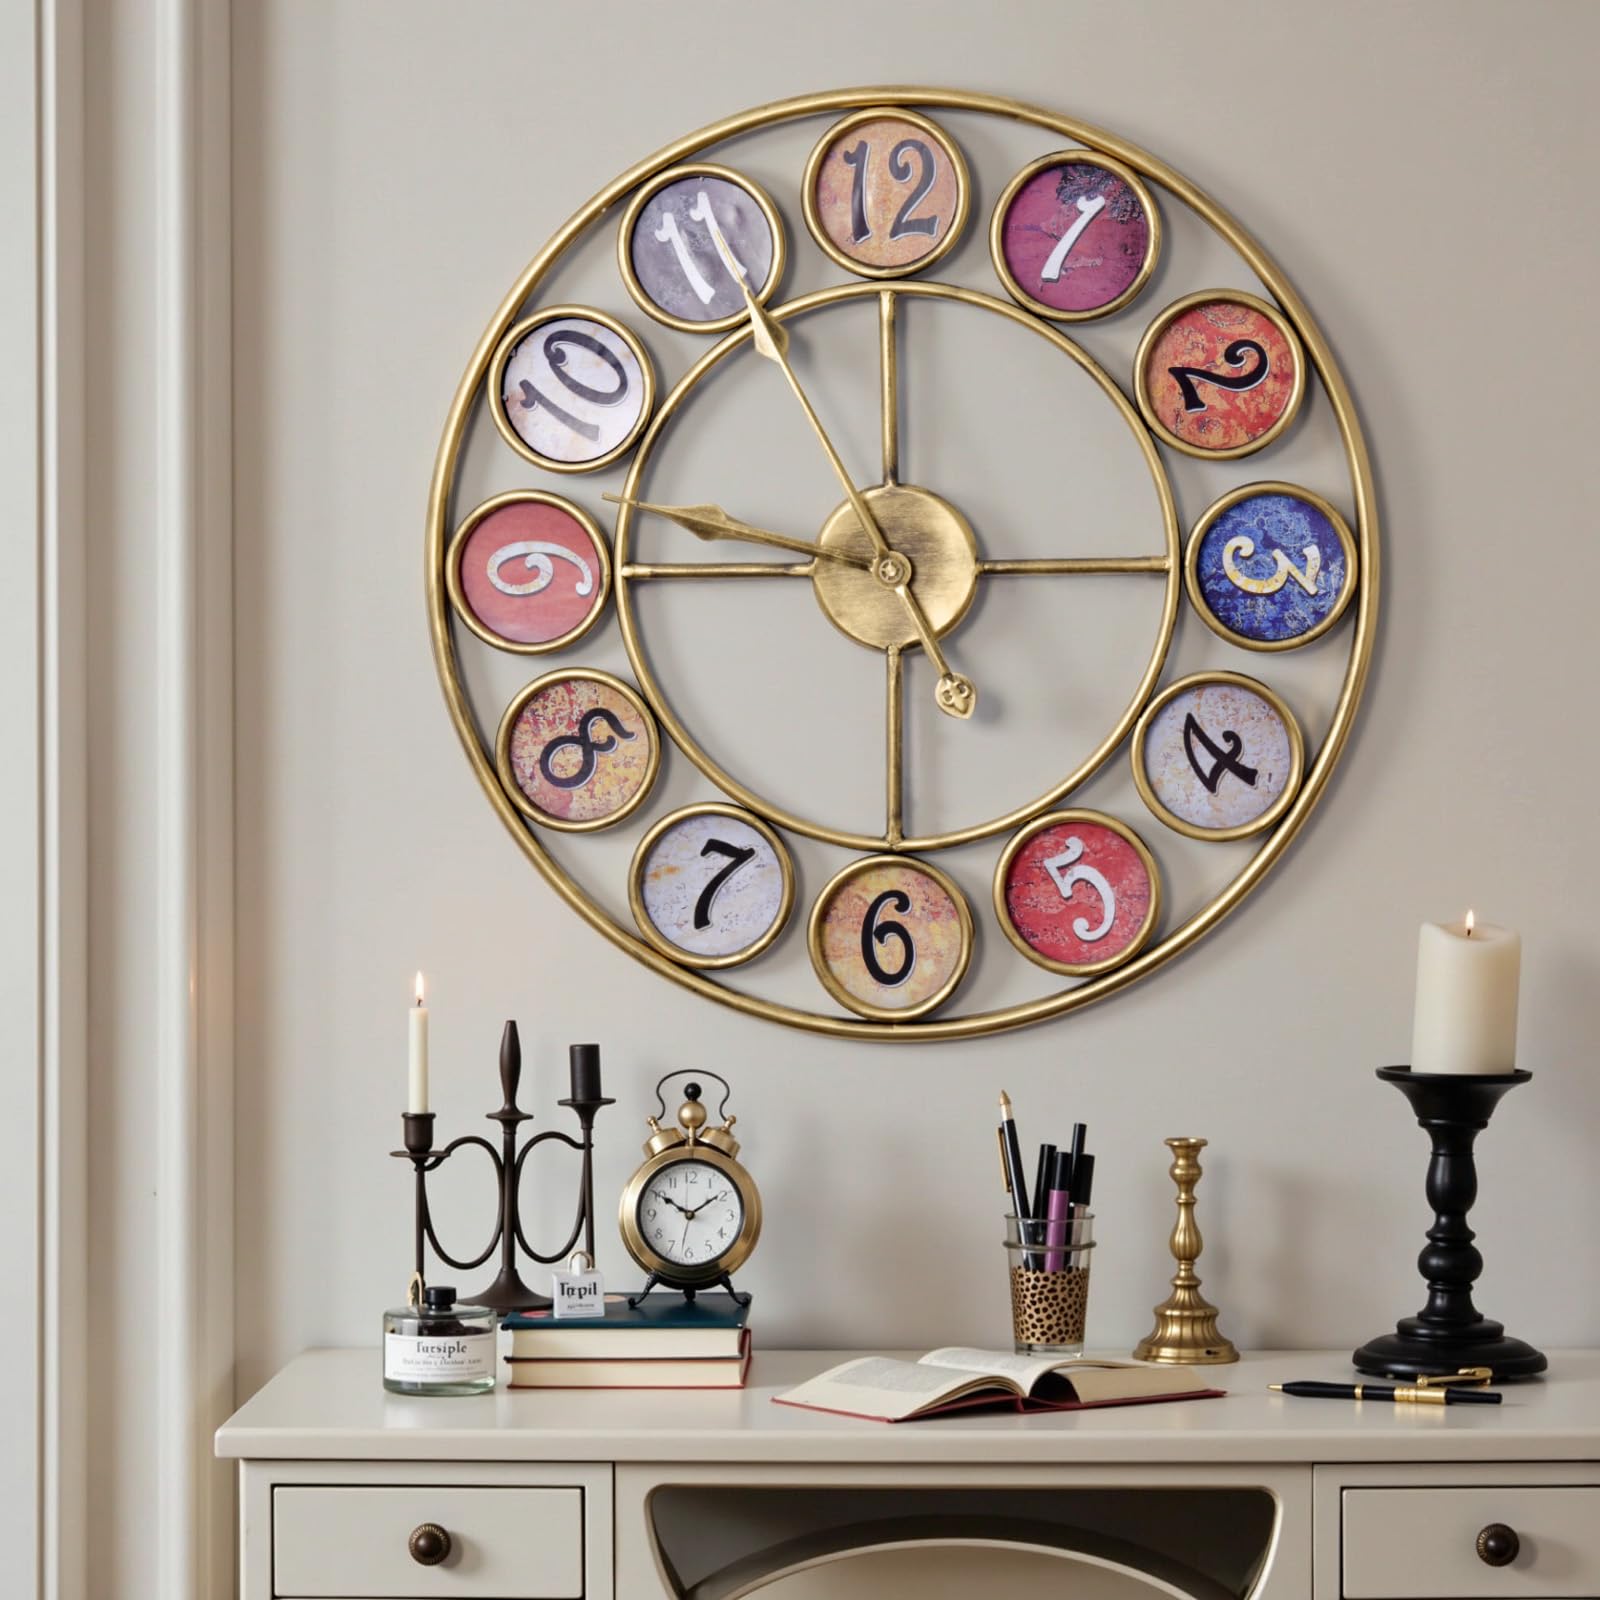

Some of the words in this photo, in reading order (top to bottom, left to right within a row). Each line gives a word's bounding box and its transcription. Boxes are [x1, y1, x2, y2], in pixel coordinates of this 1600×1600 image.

[843, 139, 941, 243] 12
[657, 191, 747, 304] 11
[1041, 195, 1107, 284] 1
[520, 330, 629, 441] 10
[1167, 338, 1271, 413] 2
[486, 539, 592, 595] 9
[1222, 535, 1321, 596] 3
[539, 708, 637, 788] 8
[1183, 712, 1259, 794] 4
[693, 837, 758, 931] 7
[1043, 837, 1116, 941] 5
[860, 890, 917, 987] 6
[669, 1178, 676, 1188] 11
[685, 1171, 698, 1184] 12
[708, 1178, 711, 1188] 1
[719, 1191, 728, 1201] 2
[648, 1210, 656, 1222] 9
[655, 1228, 663, 1238] 8
[718, 1227, 726, 1238] 4
[727, 1210, 734, 1221] 3
[668, 1240, 675, 1252] 7
[685, 1248, 693, 1258] 6
[705, 1241, 712, 1252] 5
